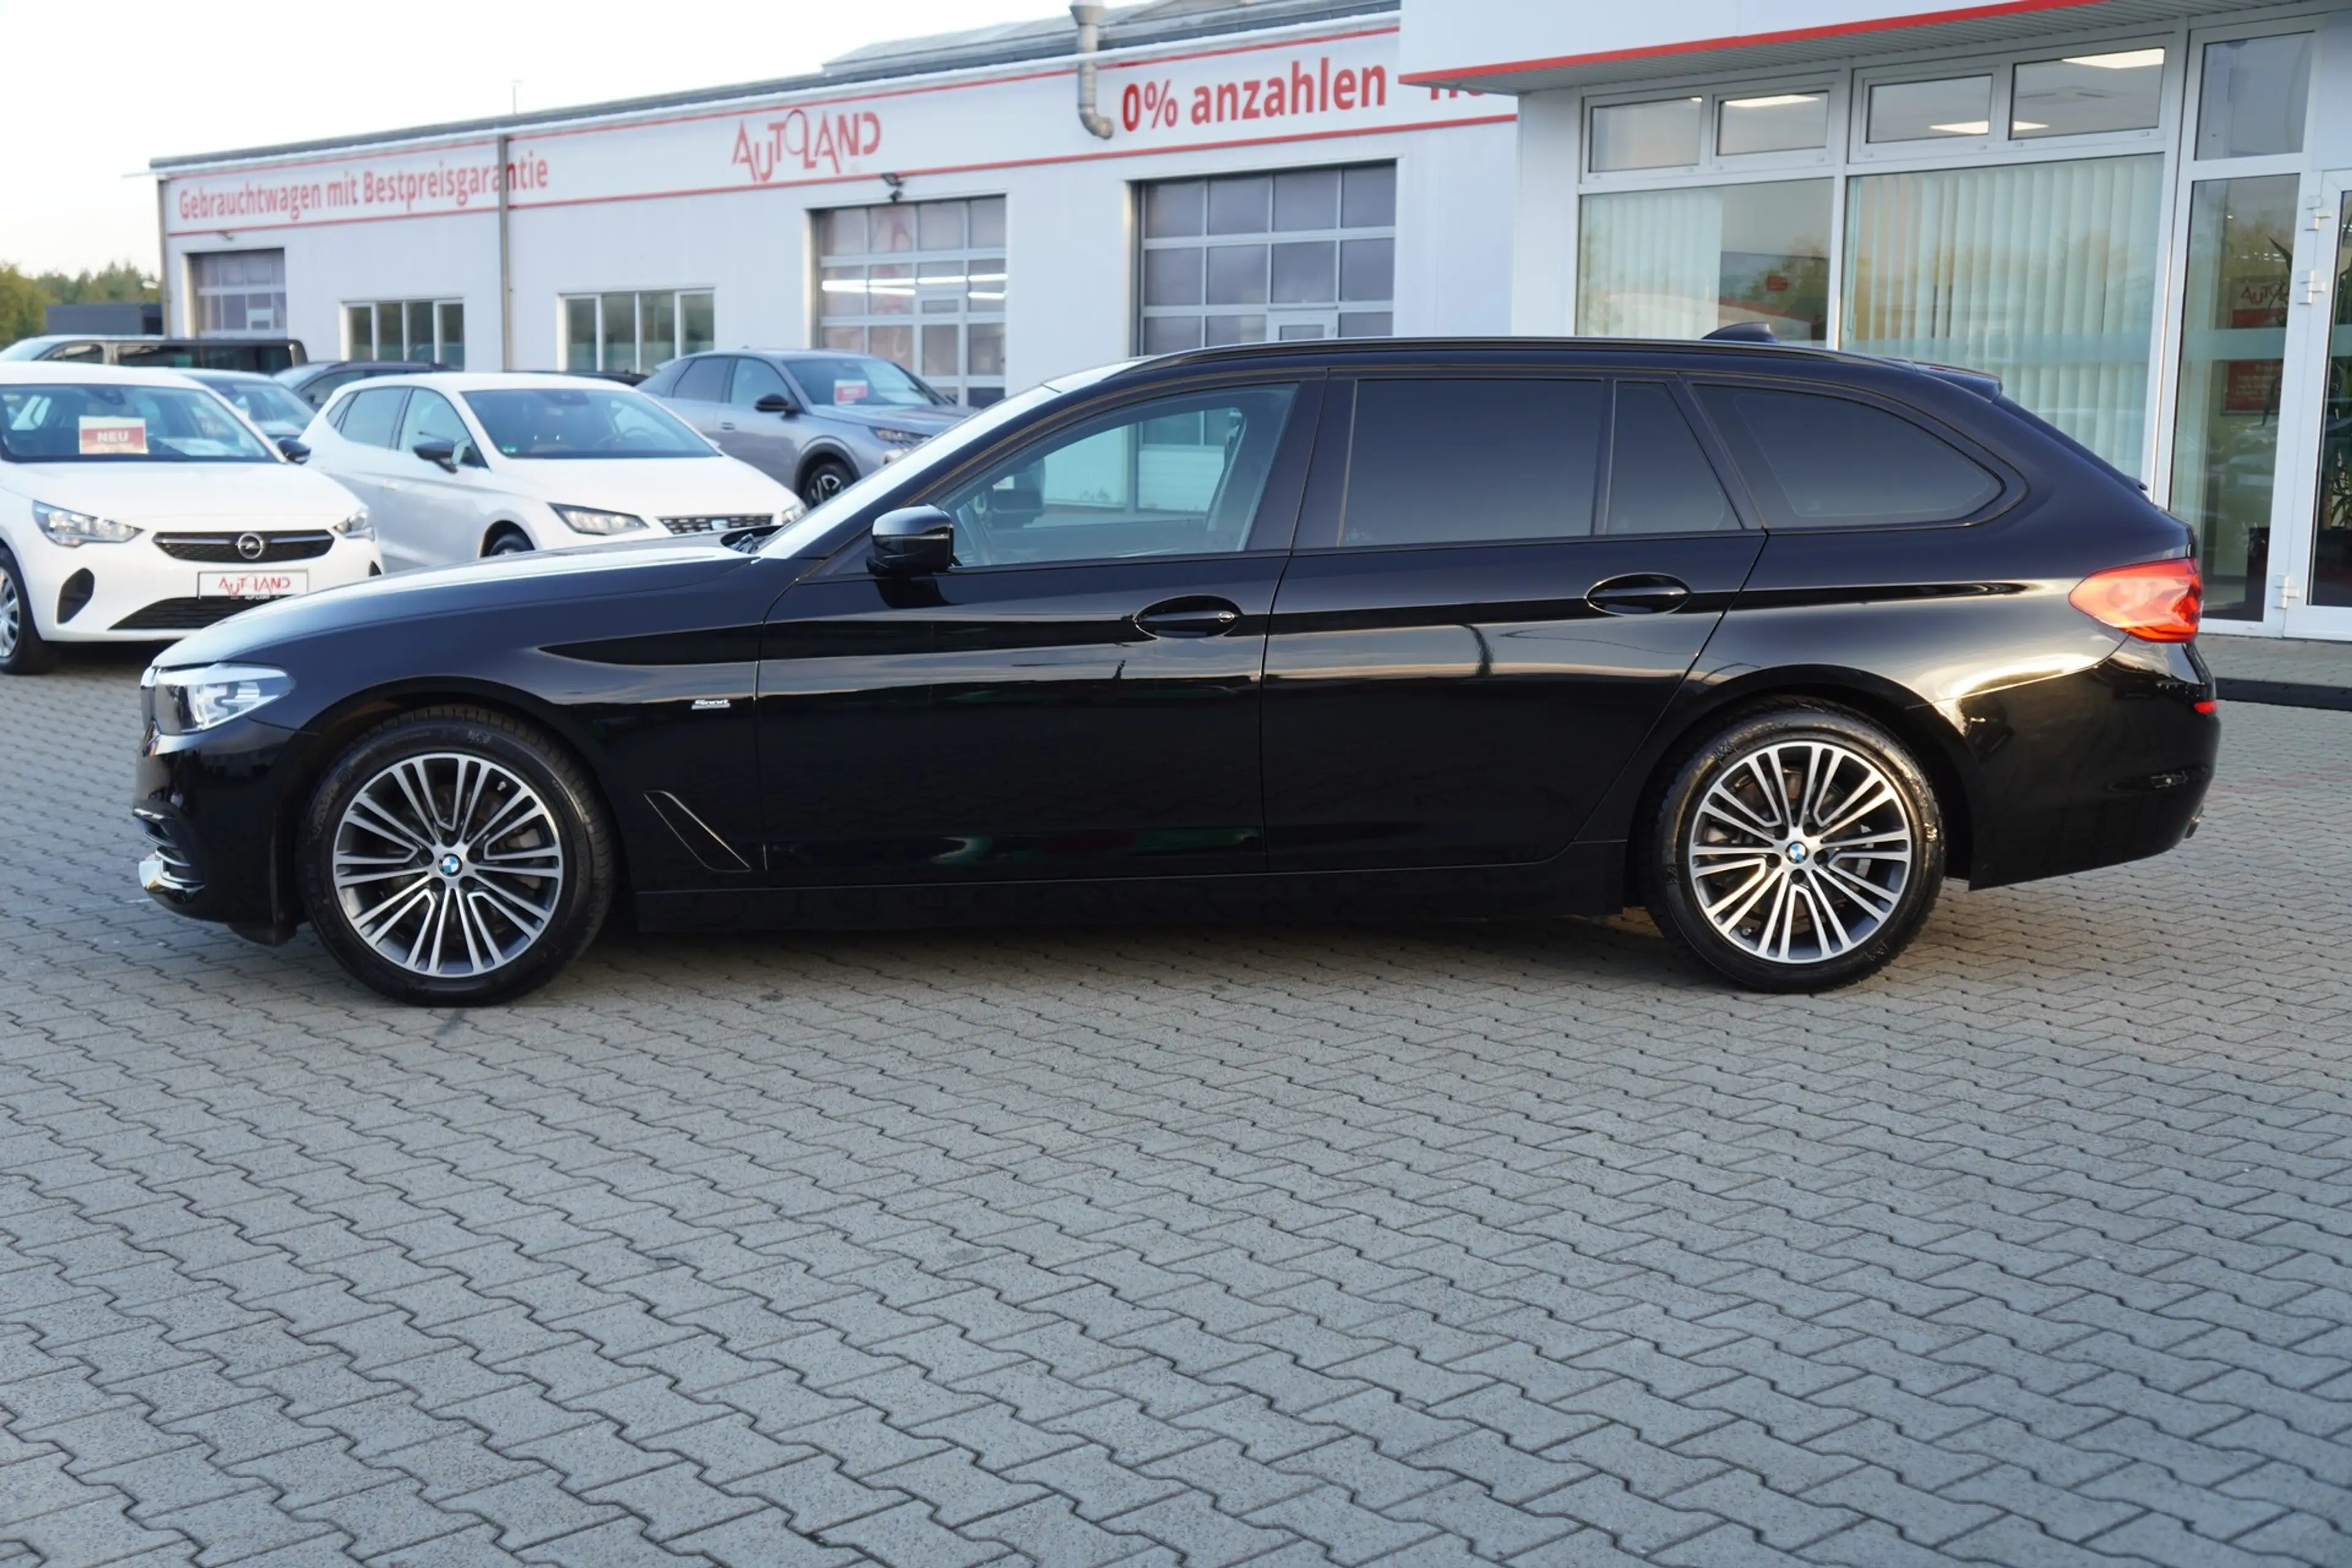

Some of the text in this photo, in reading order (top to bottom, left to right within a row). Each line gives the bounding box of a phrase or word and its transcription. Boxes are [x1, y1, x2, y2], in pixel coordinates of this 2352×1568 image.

[1121, 57, 1387, 132] 0% anzahlen
[179, 149, 549, 221] Gebrauchtwagen mit Bestpreisgarantie
[96, 431, 129, 443] NEU
